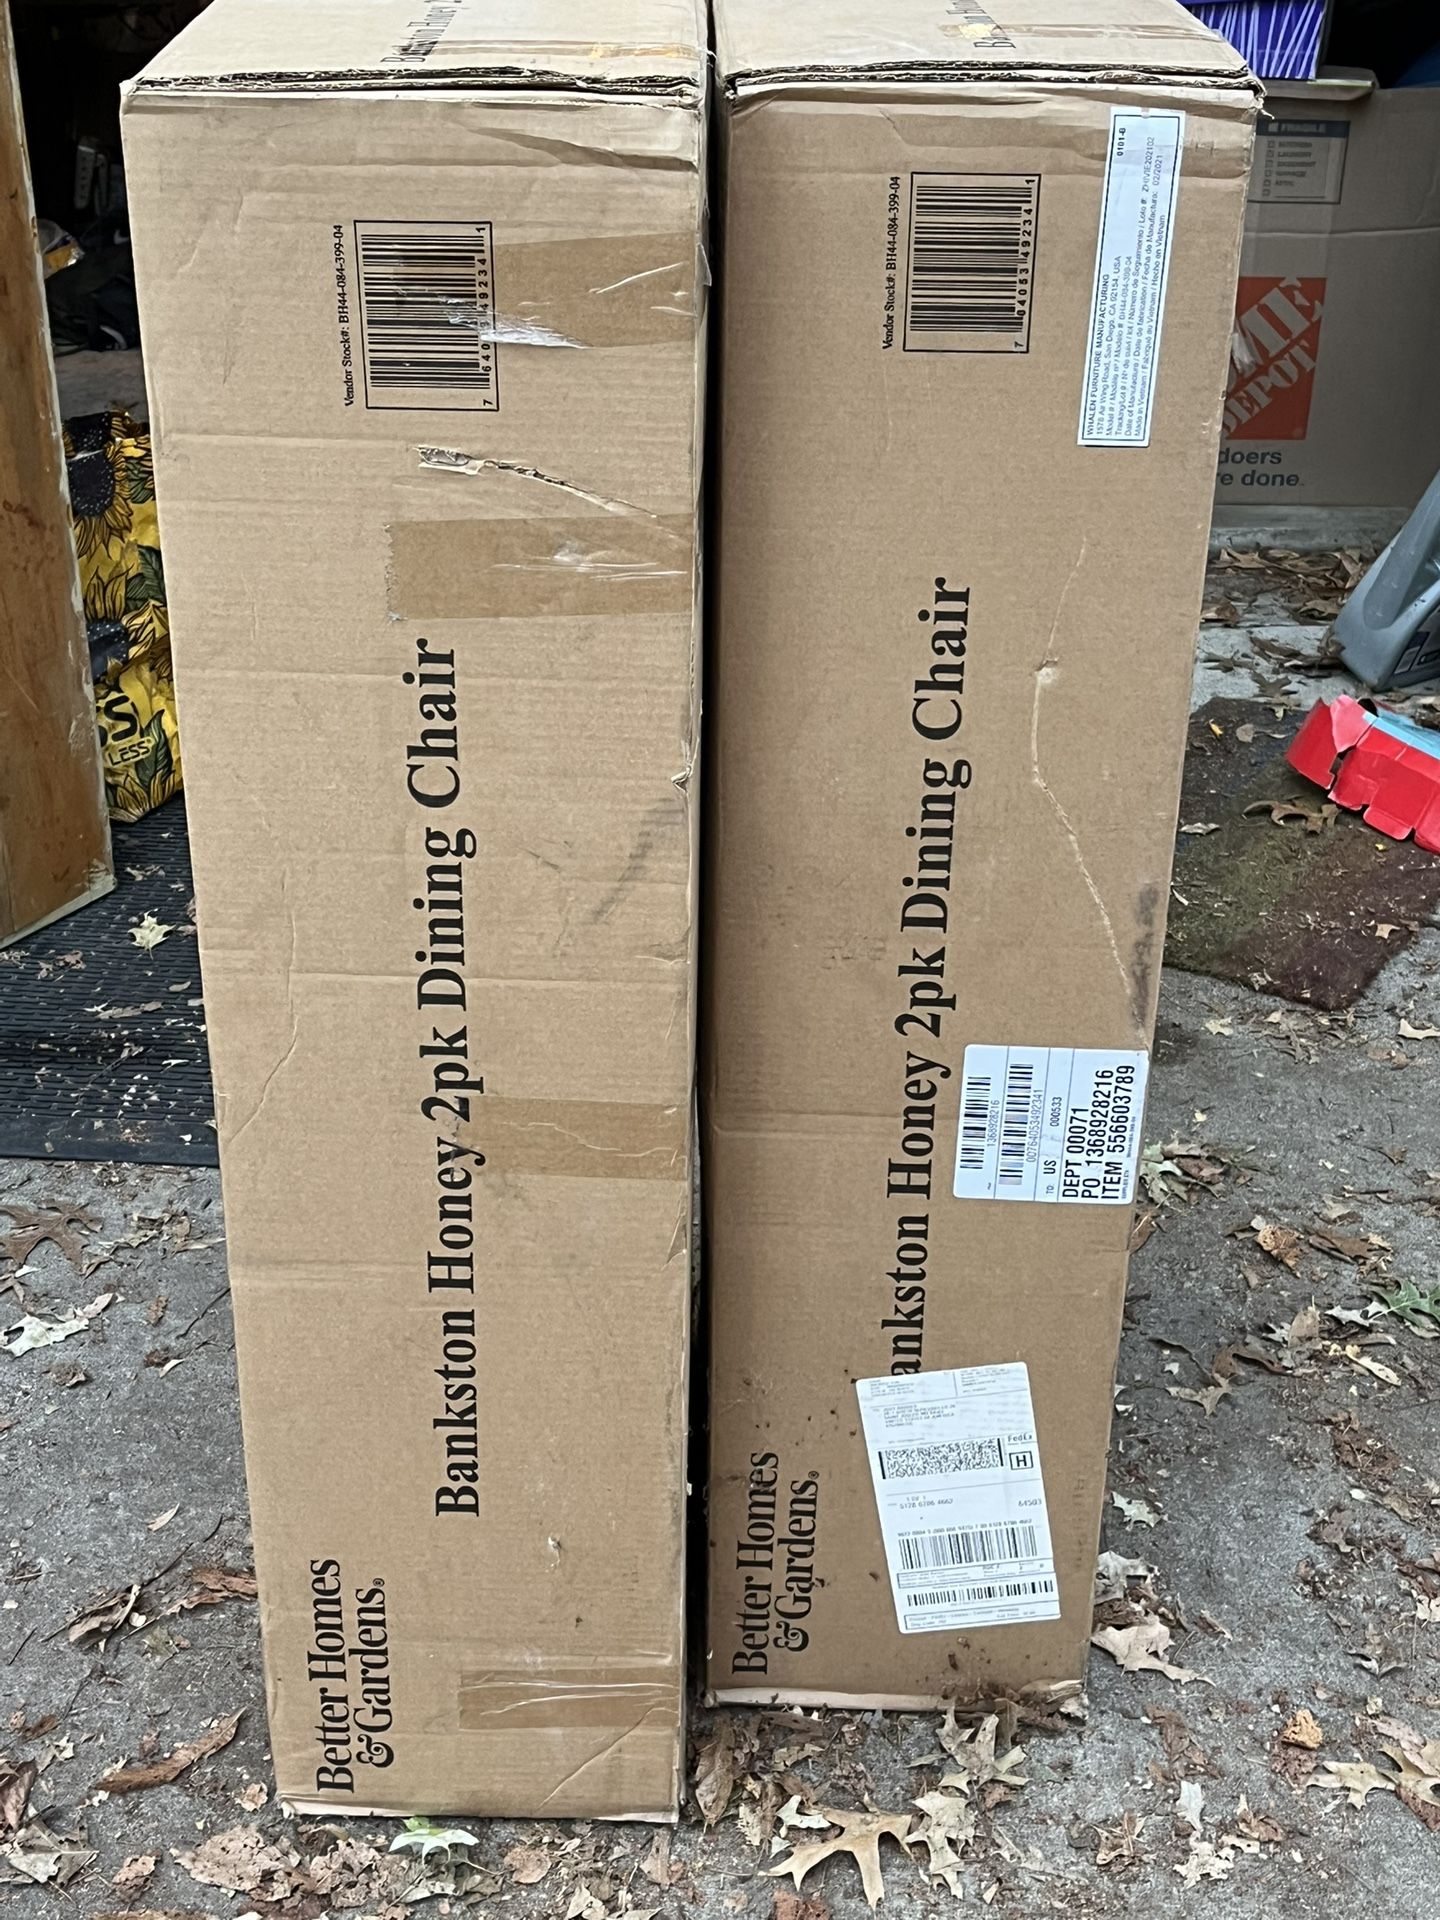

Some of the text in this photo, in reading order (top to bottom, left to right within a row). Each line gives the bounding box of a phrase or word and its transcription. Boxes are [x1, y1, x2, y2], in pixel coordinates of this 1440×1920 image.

[882, 176, 900, 350] Vendor Stock#: BH44-084-399-04
[1142, 256, 1151, 279] Fecha
[1151, 260, 1160, 285] Hecho
[1155, 215, 1165, 247] Vietnam
[333, 225, 354, 406] Vendor Stock#: BH44-084-399-04
[1104, 344, 1112, 358] San
[1108, 303, 1116, 315] CA
[1113, 255, 1121, 273] USA
[1133, 338, 1142, 356] Date
[1136, 287, 1147, 325] fabrication
[1147, 291, 1157, 322] Vietnam
[1086, 274, 1109, 435] WHALEN FURNITURE MANUFACTURING
[1137, 375, 1147, 405] Vietnam
[1124, 419, 1133, 435] Date
[1134, 415, 1142, 436] Made
[911, 576, 970, 740] Chair
[108, 740, 151, 766] LESS
[900, 758, 972, 934] Dining
[894, 946, 957, 1038] 2pk
[402, 637, 485, 1517] Bankston Honey 2pk Dining Chair
[1049, 1096, 1061, 1126] 000533
[887, 1050, 952, 1200] Honey
[986, 1099, 999, 1146] 1368928216
[1043, 1159, 1056, 1174] US
[1061, 1107, 1088, 1197] DEPT 00071
[1081, 1069, 1113, 1198] PO 1368928216
[1101, 1064, 1134, 1199] ITEM 556603789
[881, 1213, 929, 1376] ankston
[1015, 1454, 1027, 1467] H
[731, 1452, 779, 1675] Better Homes
[307, 1559, 354, 1793] Better Homes
